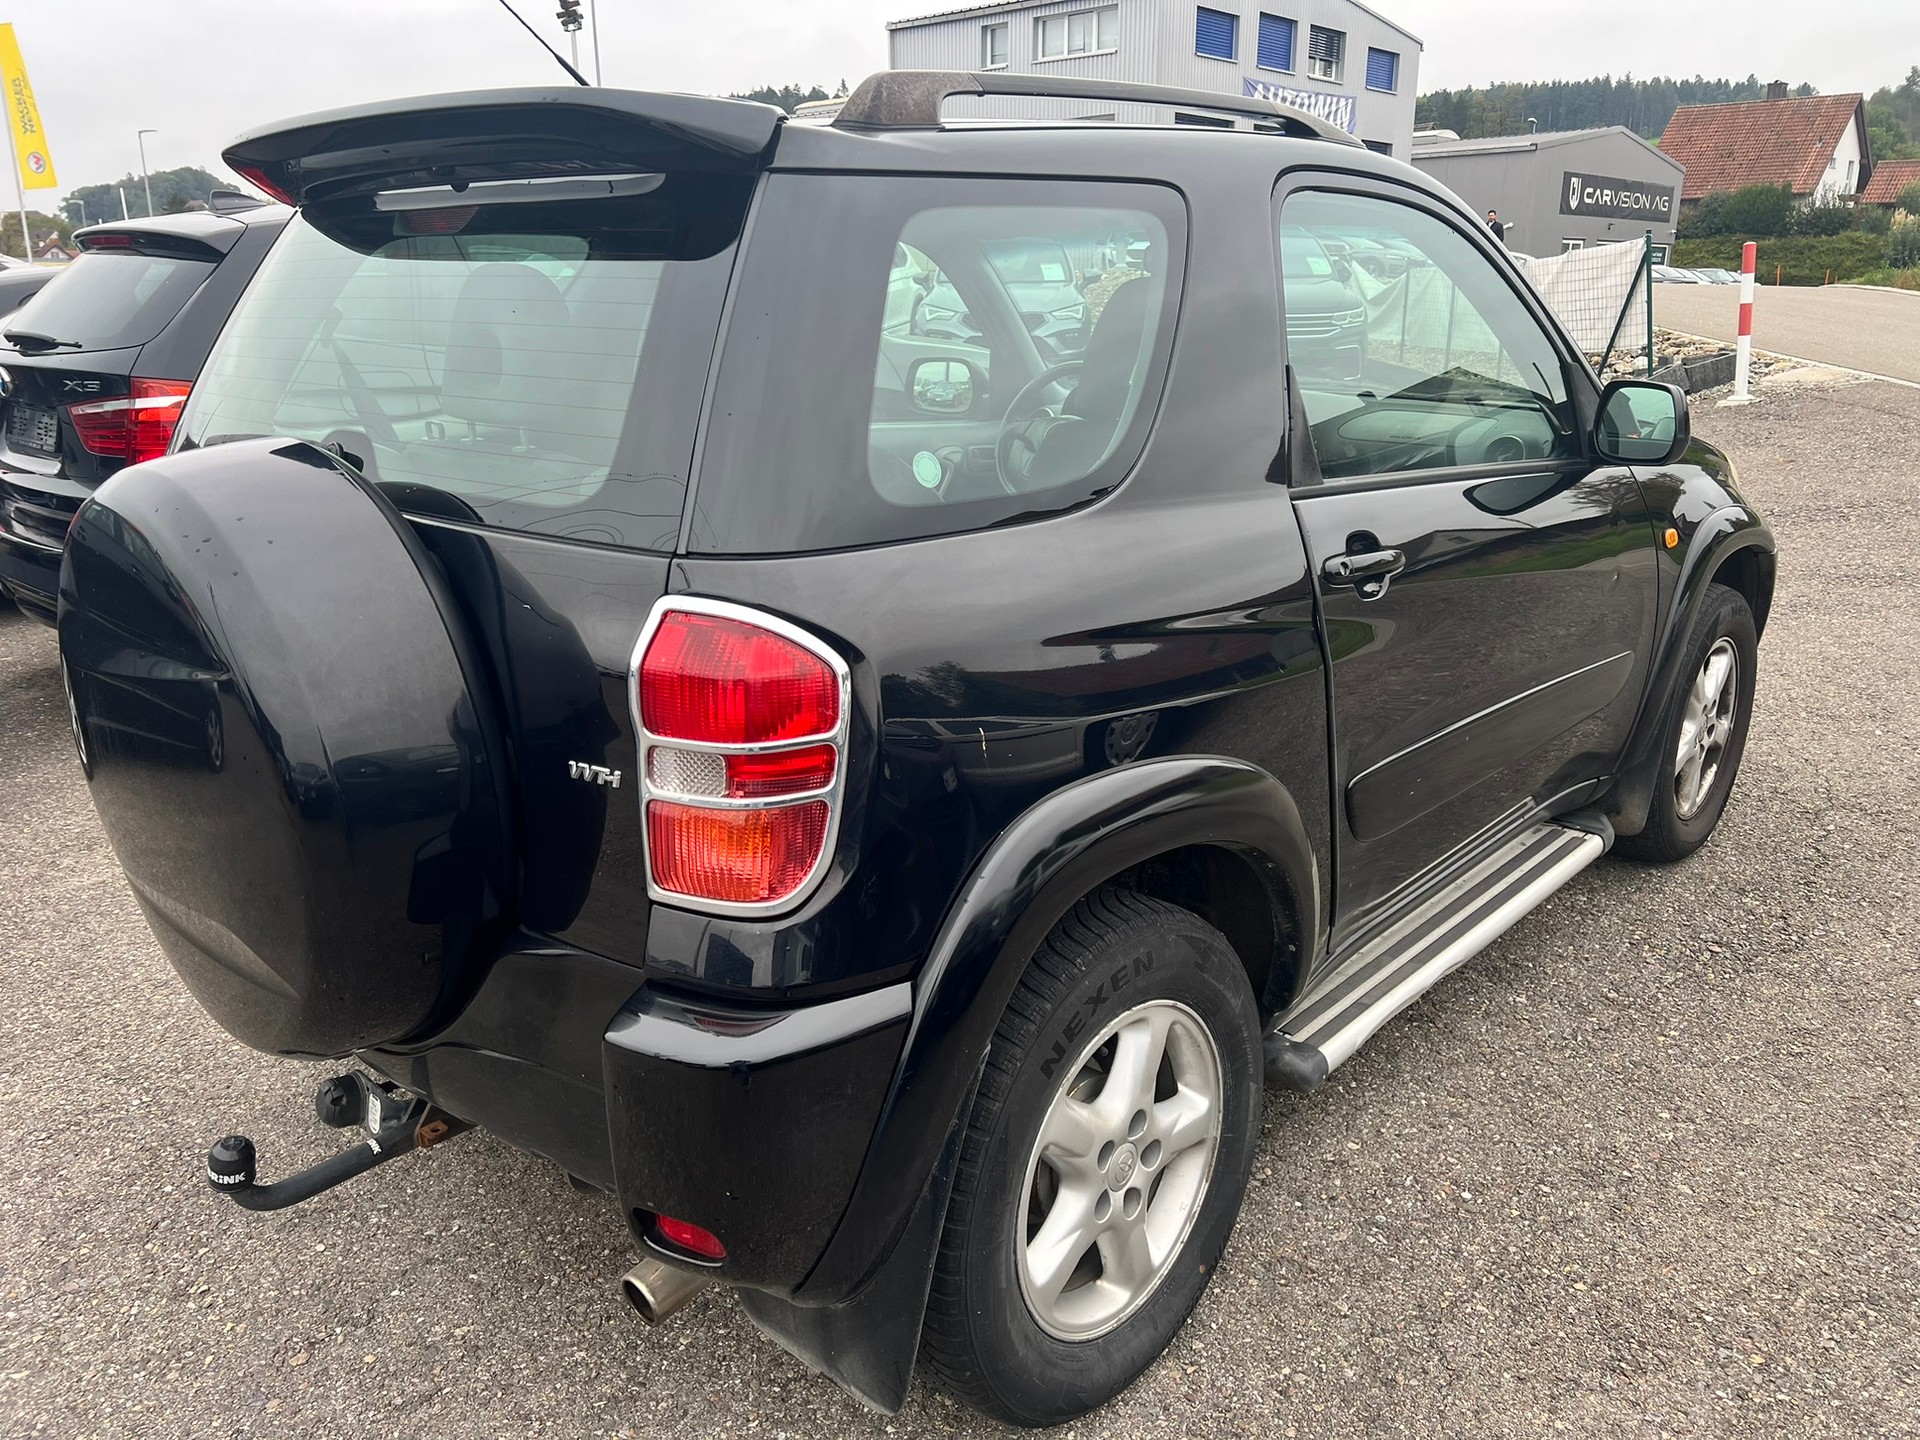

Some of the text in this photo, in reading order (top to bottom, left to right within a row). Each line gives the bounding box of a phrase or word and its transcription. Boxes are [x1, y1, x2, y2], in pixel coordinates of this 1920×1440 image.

[1583, 187, 1670, 211] CARVISION AG
[62, 379, 101, 392] X3
[1039, 950, 1155, 1081] NEXEN
